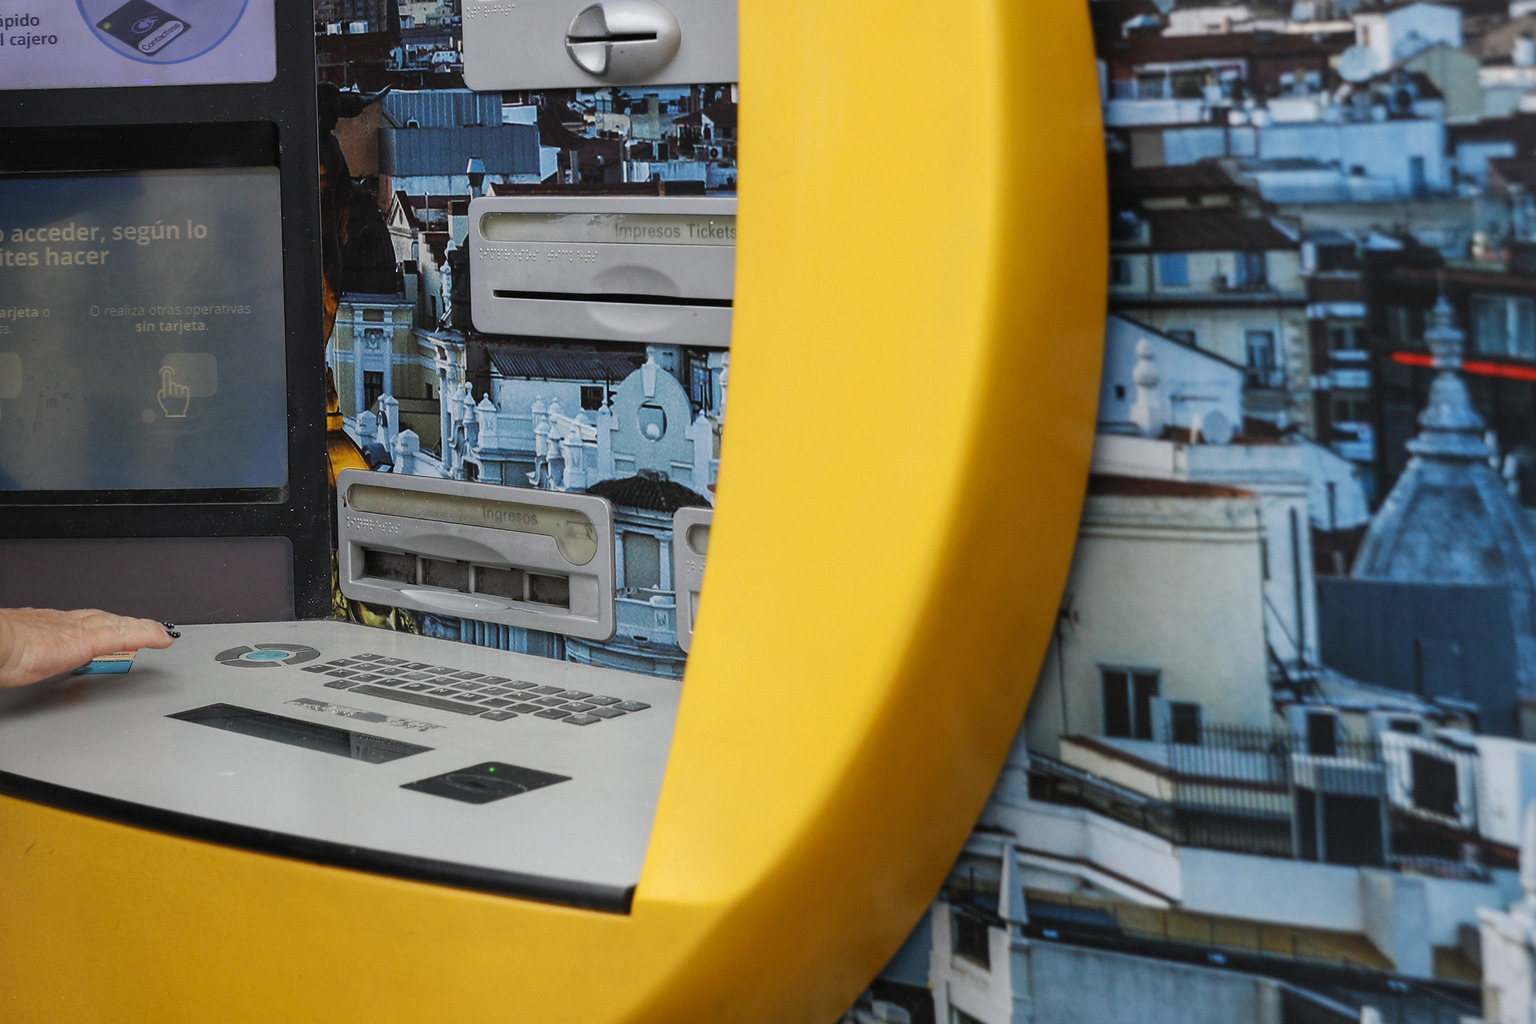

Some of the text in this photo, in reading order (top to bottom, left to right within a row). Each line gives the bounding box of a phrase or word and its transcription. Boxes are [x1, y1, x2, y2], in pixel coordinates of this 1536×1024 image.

[9, 32, 58, 49] cajero
[141, 21, 182, 52] Contactless
[11, 222, 106, 244] acceder,
[112, 220, 180, 246] según
[186, 219, 208, 240] lo
[614, 223, 736, 240] Impresos Tickets
[45, 246, 110, 266] hacer
[42, 308, 50, 318] o
[89, 303, 251, 318] O realiza otras operativas
[135, 319, 209, 335] sin tarjeta.
[482, 505, 538, 525] Ingresos
